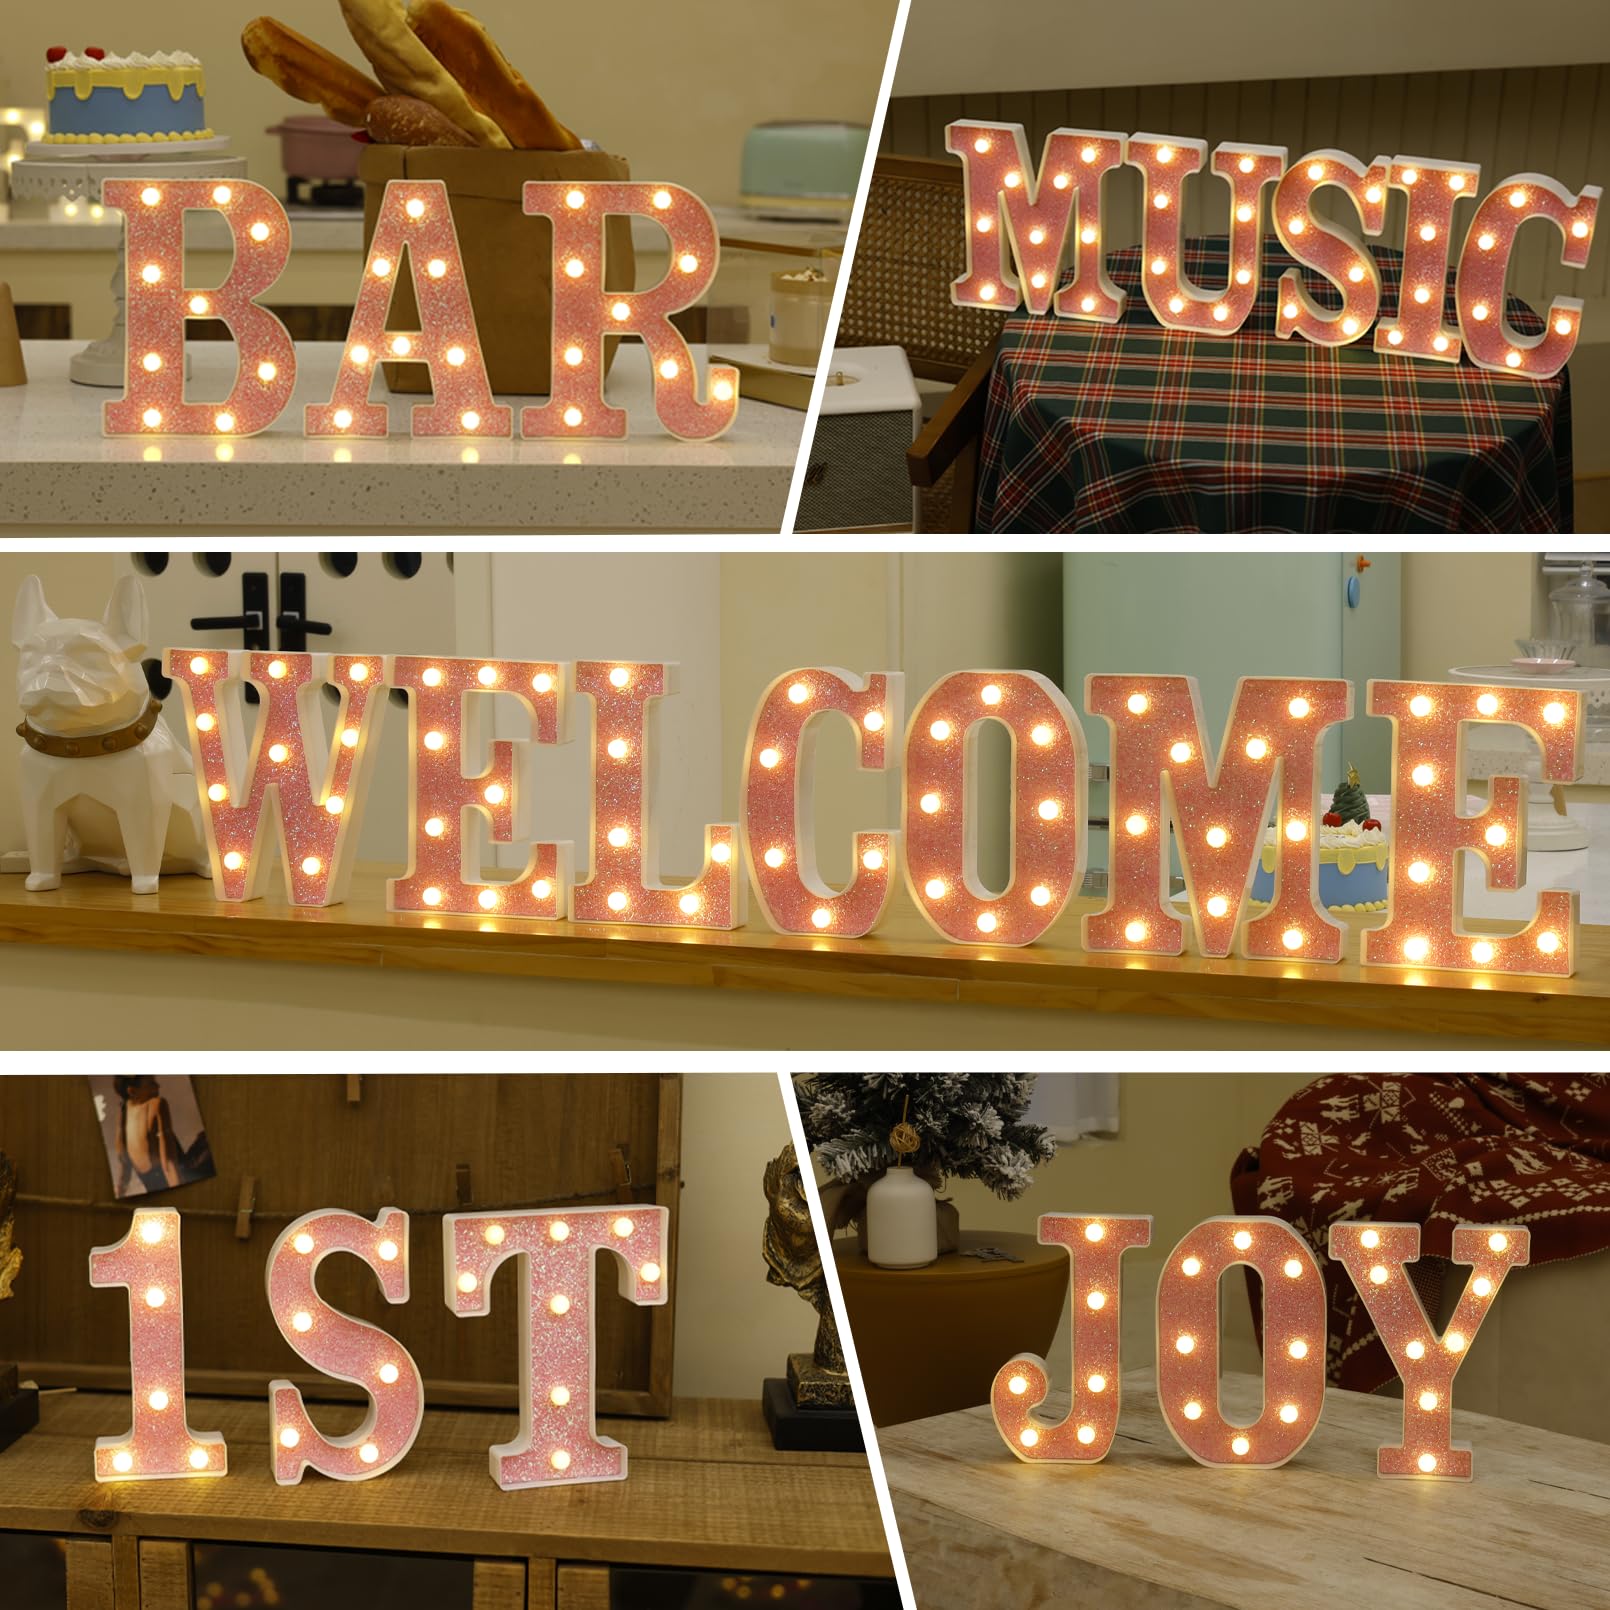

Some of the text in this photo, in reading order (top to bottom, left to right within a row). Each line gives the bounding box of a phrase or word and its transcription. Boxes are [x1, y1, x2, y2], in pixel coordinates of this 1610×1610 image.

[101, 178, 740, 441] BAR
[945, 119, 1602, 380] MUSIC
[162, 646, 1586, 978] WELCOME
[89, 1204, 669, 1491] 1ST
[990, 1214, 1531, 1482] JOY
